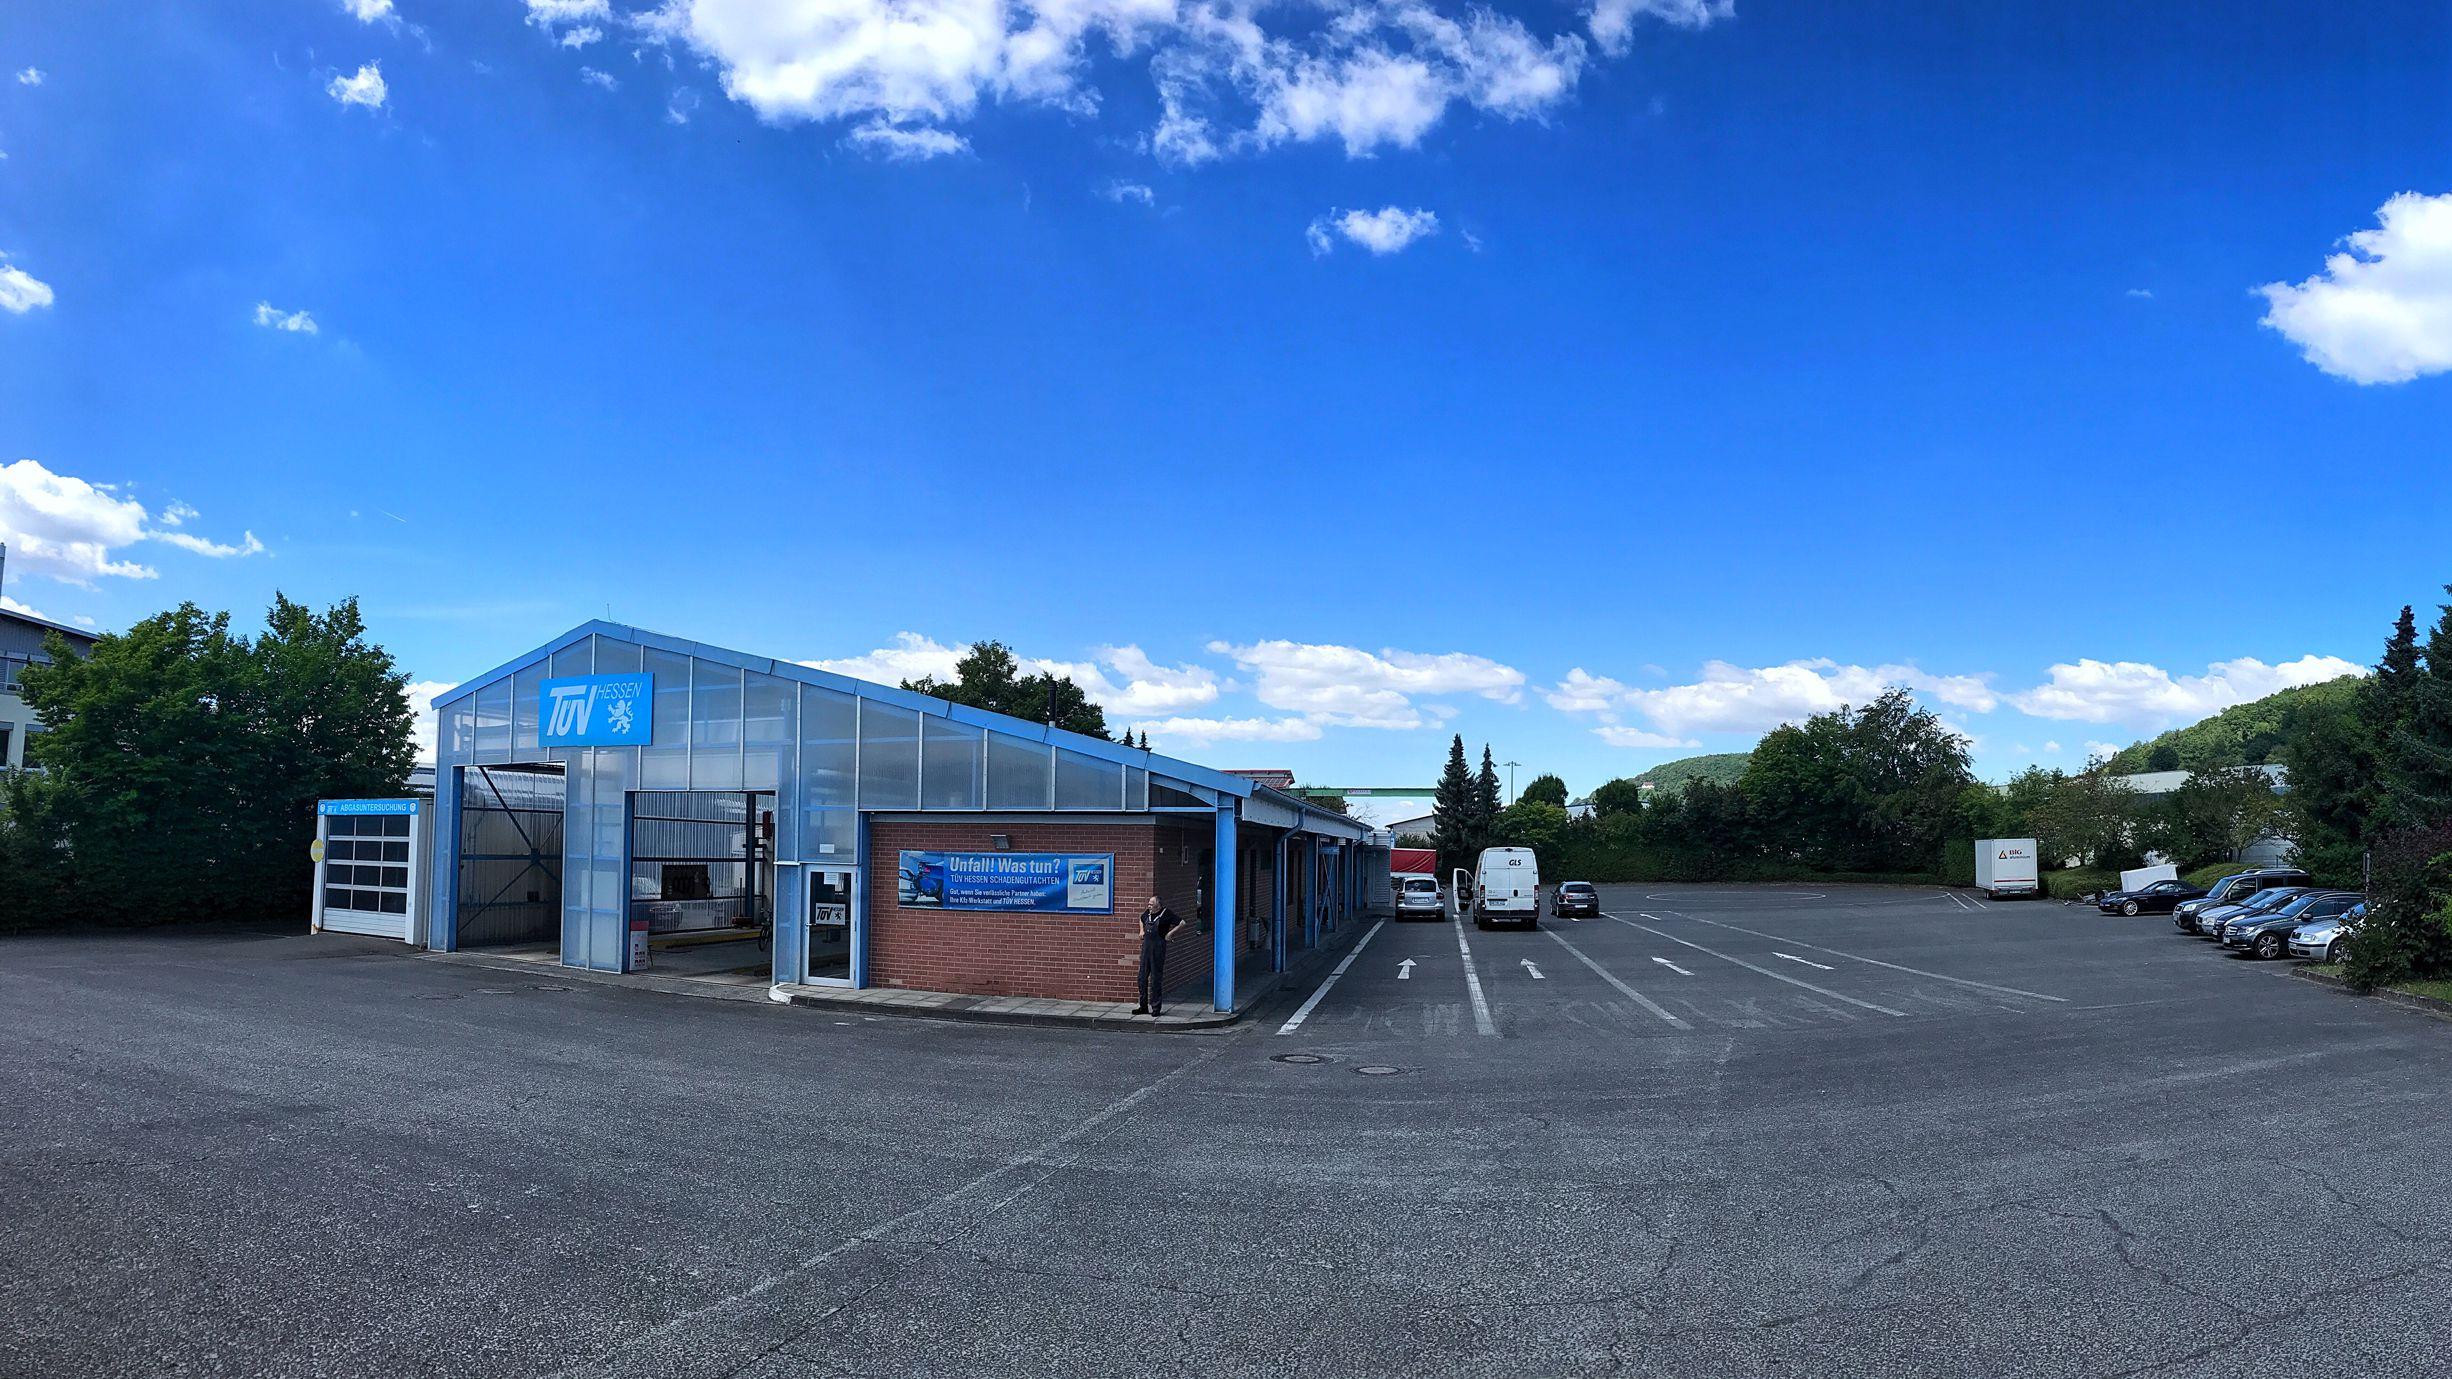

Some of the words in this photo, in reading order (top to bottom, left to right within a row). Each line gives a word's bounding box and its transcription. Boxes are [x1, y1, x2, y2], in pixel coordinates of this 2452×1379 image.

[596, 682, 643, 700] HESSEN
[547, 685, 598, 736] TÜV
[340, 803, 406, 812] ABGASUNTERSUCHUNG
[949, 857, 995, 873] Unfall!
[998, 857, 1027, 874] Was
[1029, 858, 1061, 874] tun?
[950, 873, 963, 883] TÜV
[964, 875, 988, 884] HESSEN
[989, 875, 1060, 885] SCHADENGUTACHTEN
[1074, 870, 1090, 882] TÜV
[949, 896, 960, 904] Ihre
[1003, 896, 1014, 906] TÜV
[817, 906, 833, 920] TÜV
